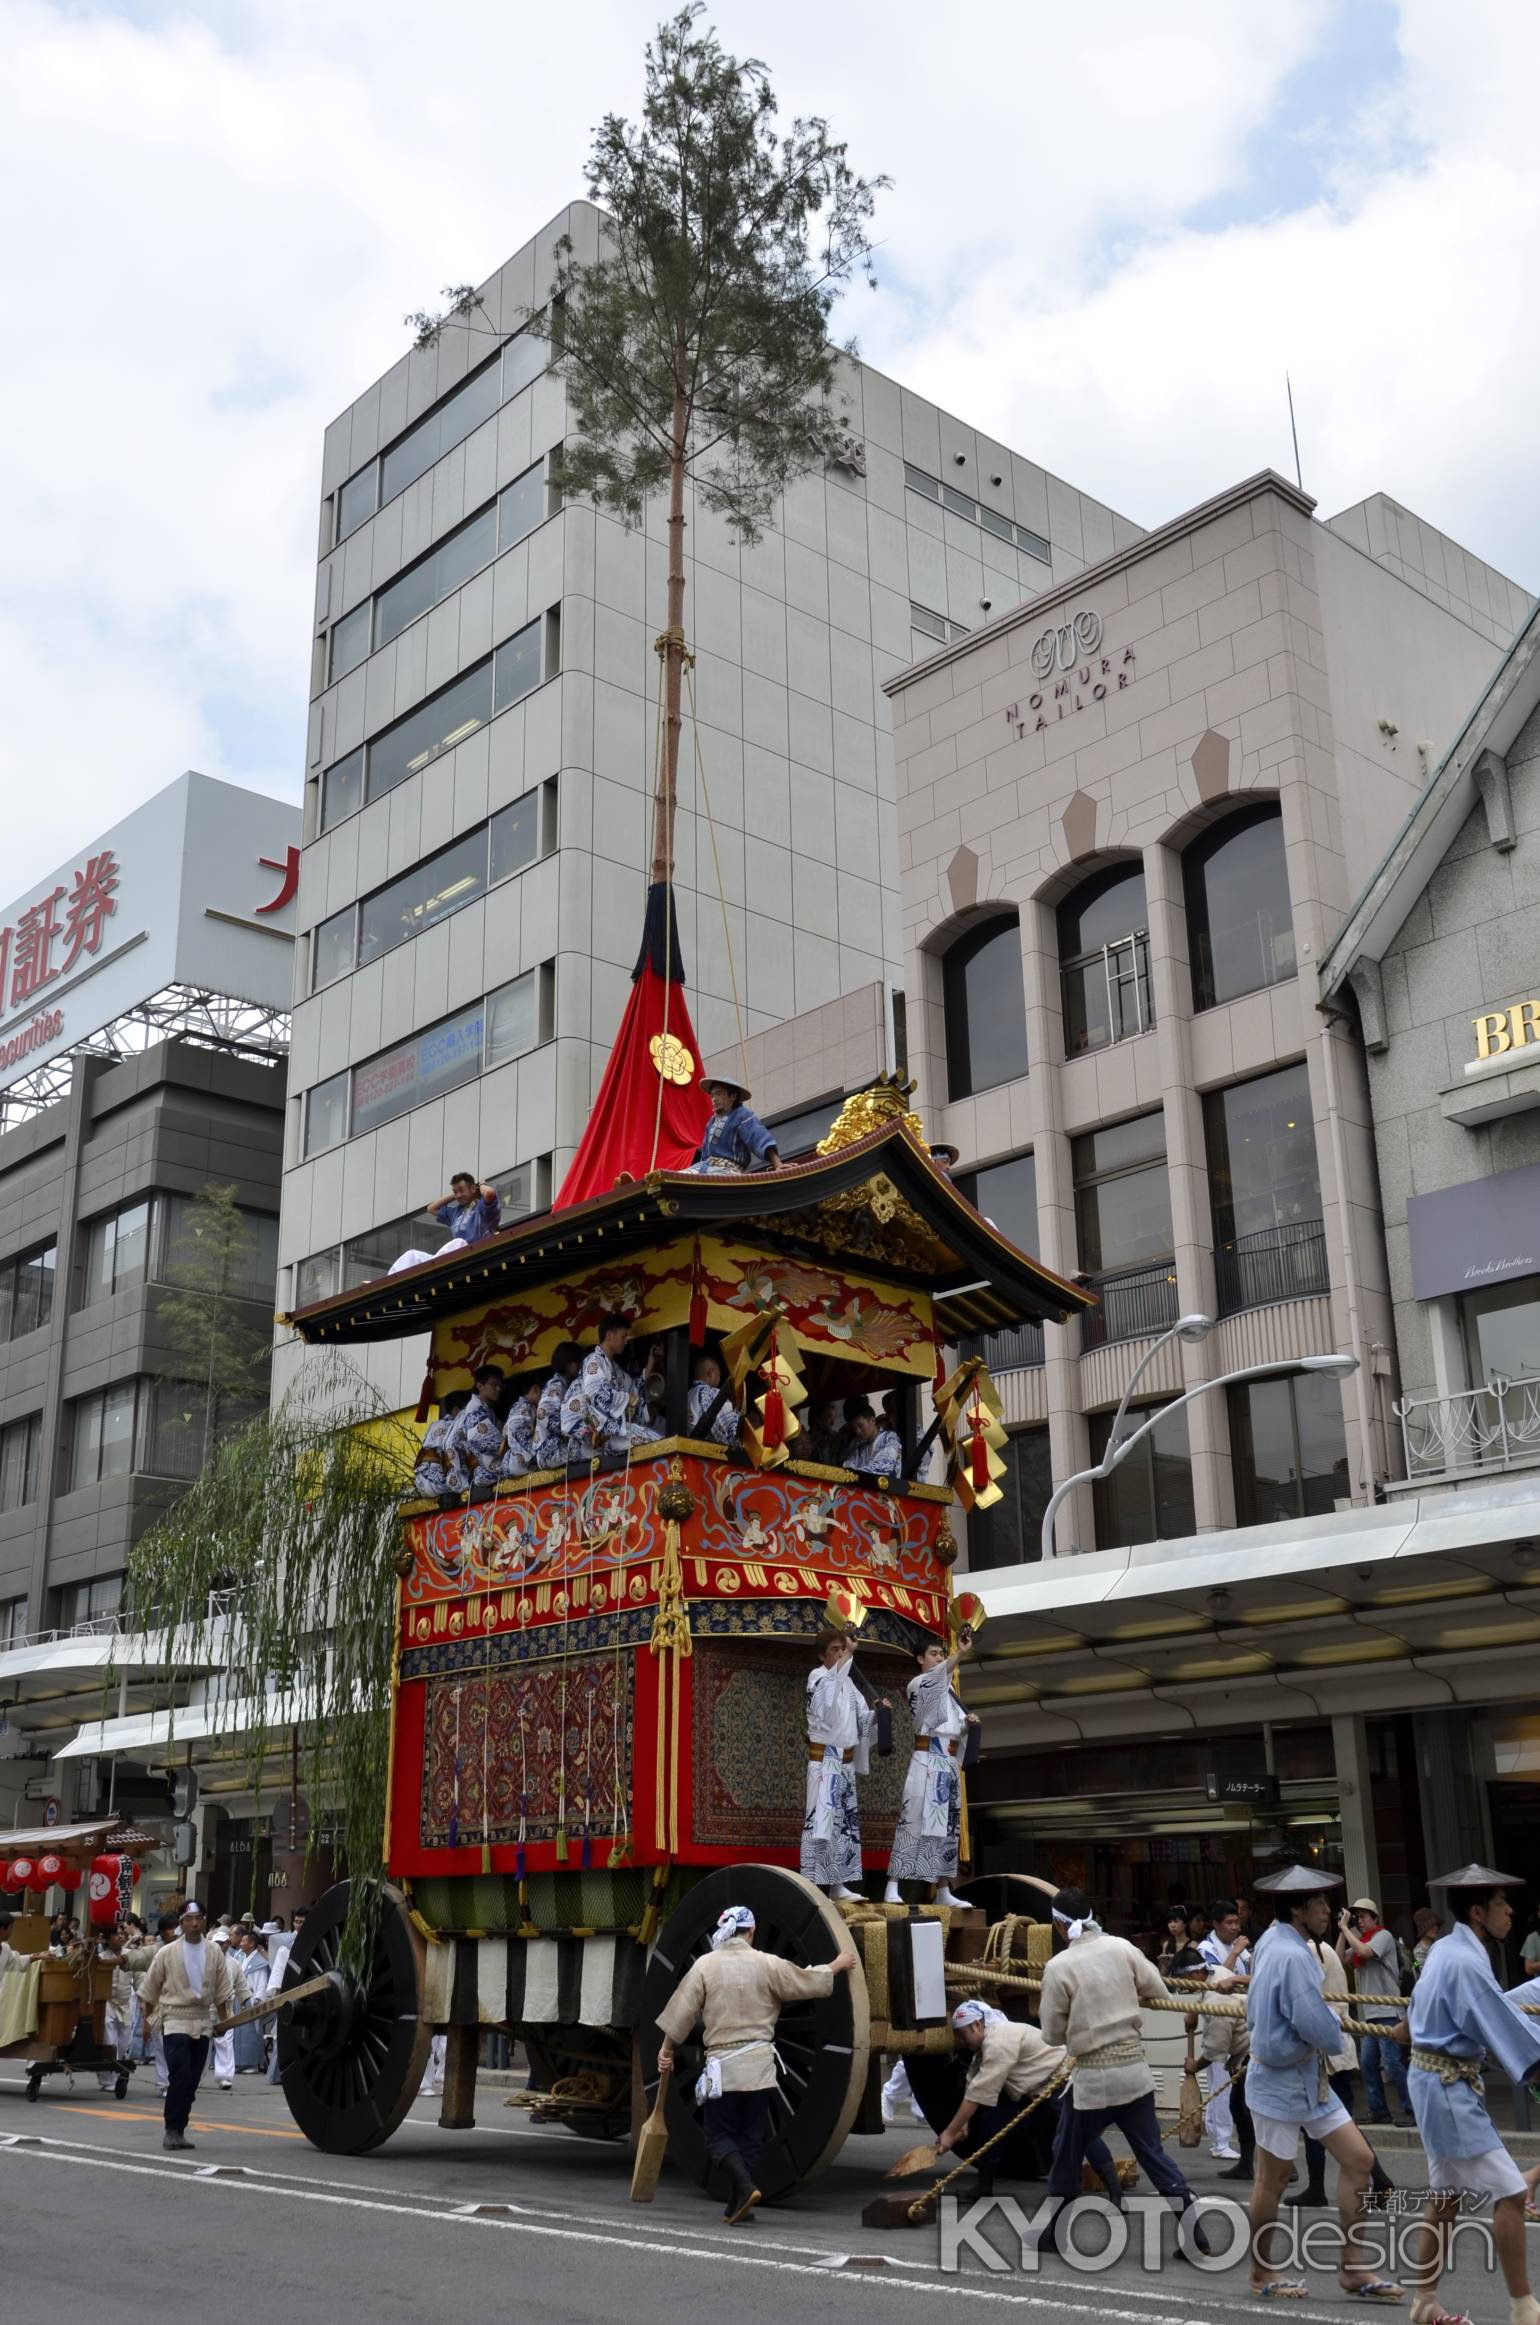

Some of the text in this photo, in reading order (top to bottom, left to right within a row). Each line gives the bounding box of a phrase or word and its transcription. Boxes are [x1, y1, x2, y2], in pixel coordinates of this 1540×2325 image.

[1006, 645, 1136, 723] NOMURA
[1017, 673, 1128, 739] TAILOR
[1472, 1000, 1540, 1060] BR
[1225, 1783, 1266, 1793] ノムラテーラー
